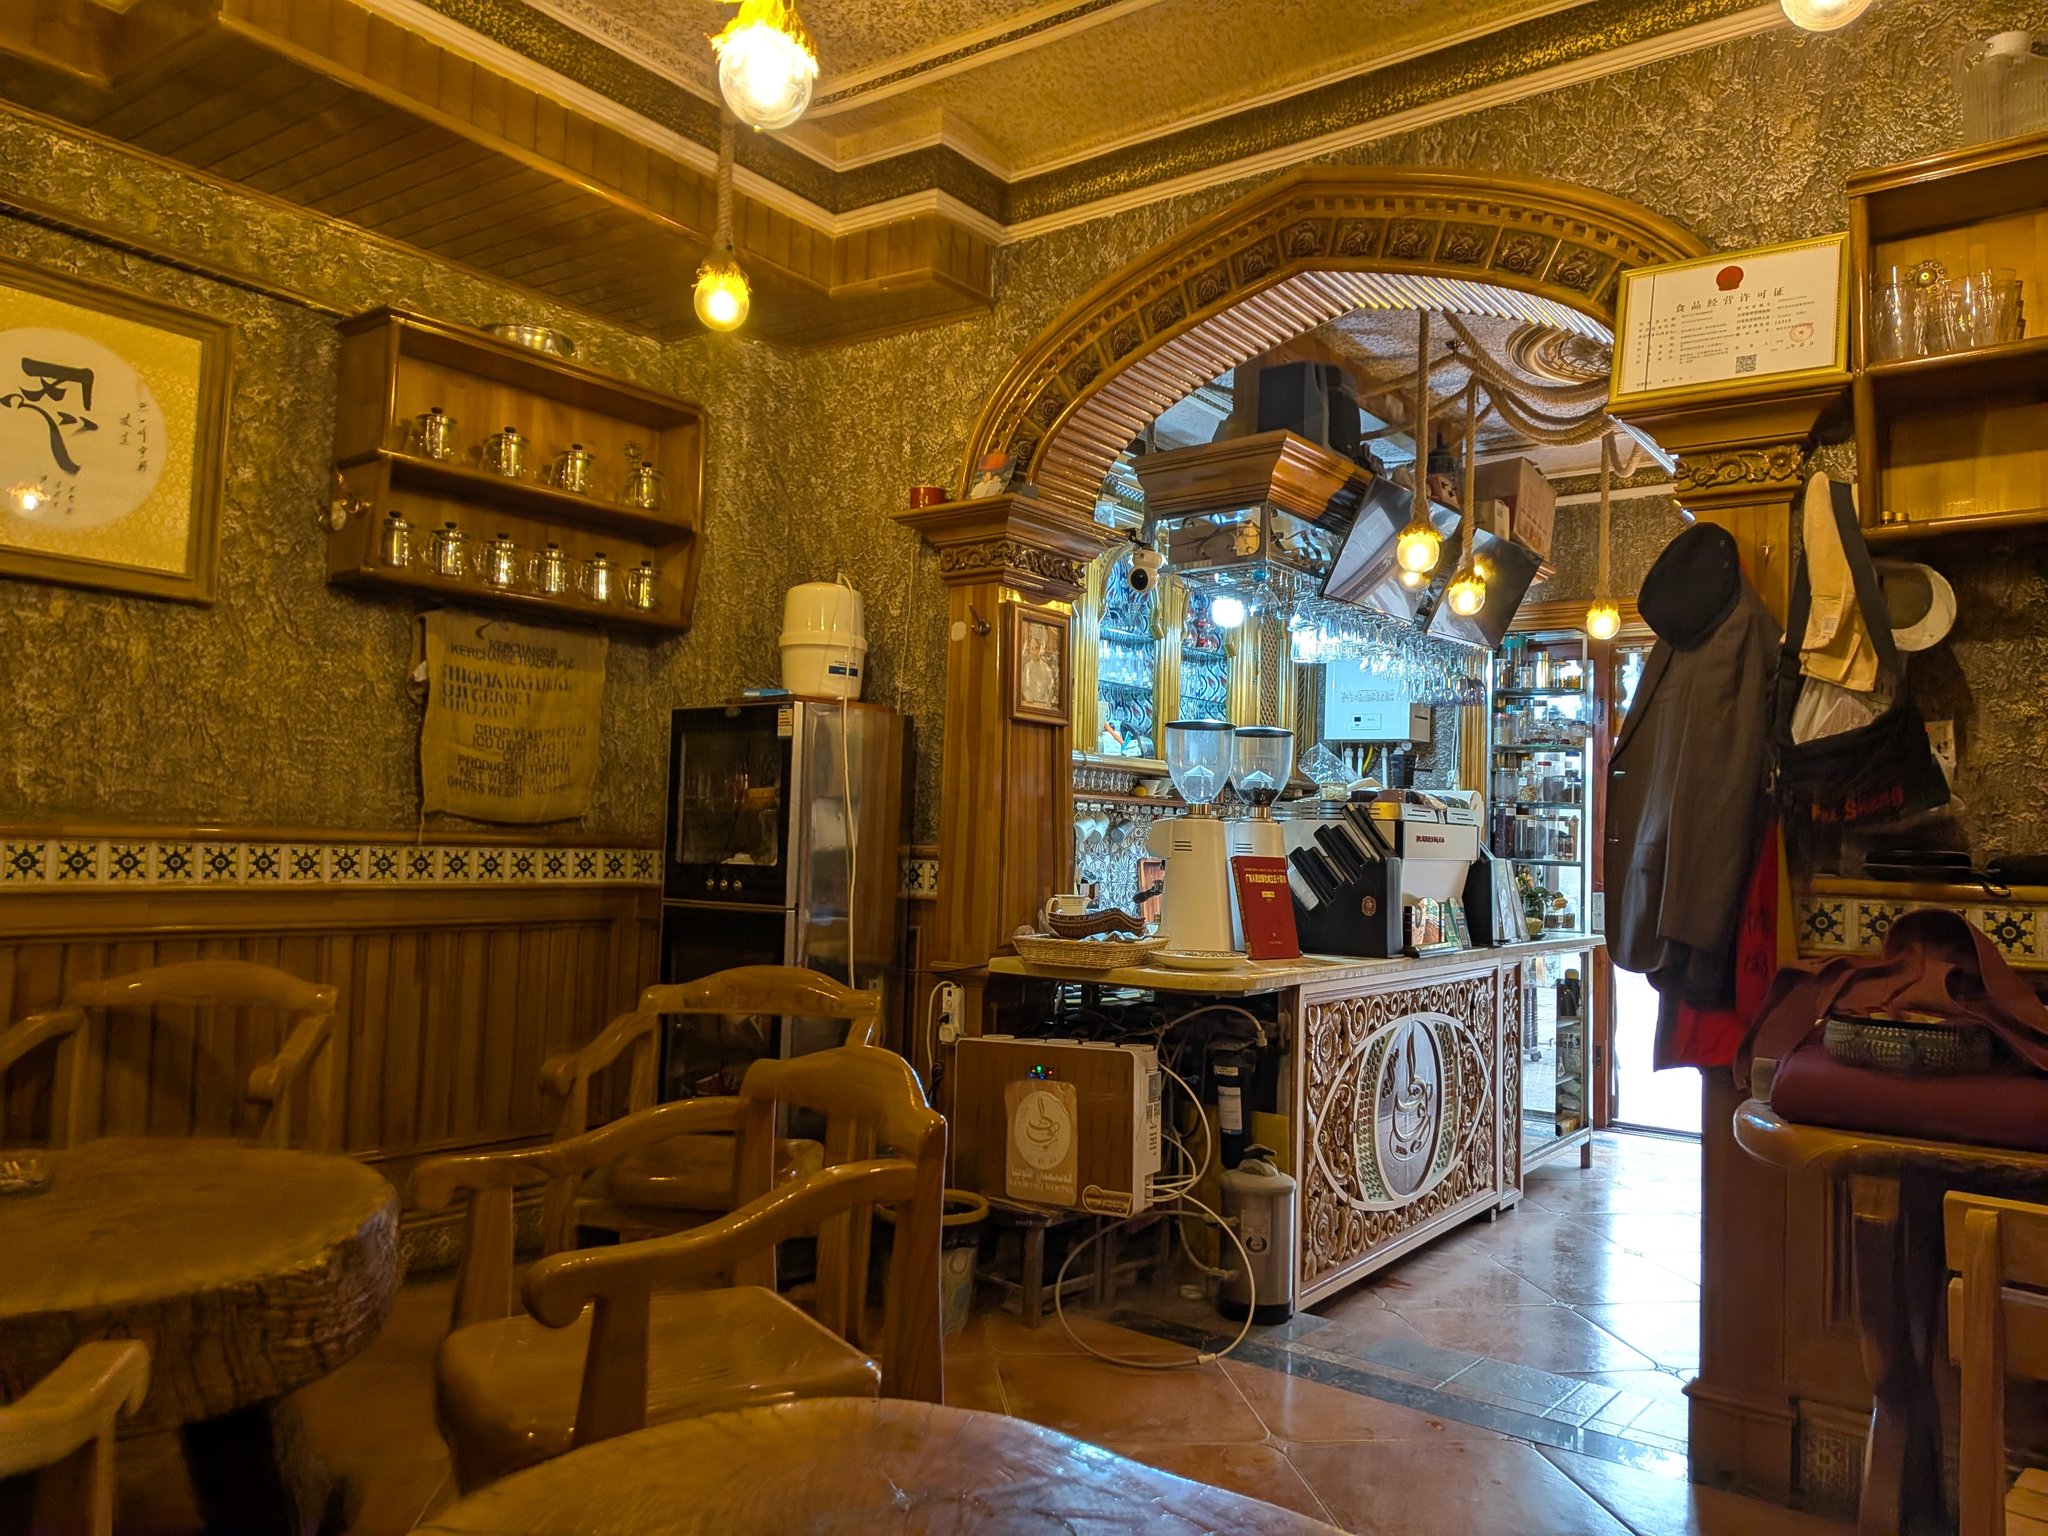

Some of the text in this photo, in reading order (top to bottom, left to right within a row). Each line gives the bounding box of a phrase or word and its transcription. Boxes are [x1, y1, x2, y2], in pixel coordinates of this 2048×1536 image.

[1675, 287, 1785, 313] 食品经营许可证
[474, 722, 511, 737] CROP
[513, 726, 544, 742] YEAR
[472, 734, 494, 749] ICO
[459, 767, 484, 781] NET
[521, 763, 571, 776] ETHIOPIA
[447, 774, 485, 794] GROSS
